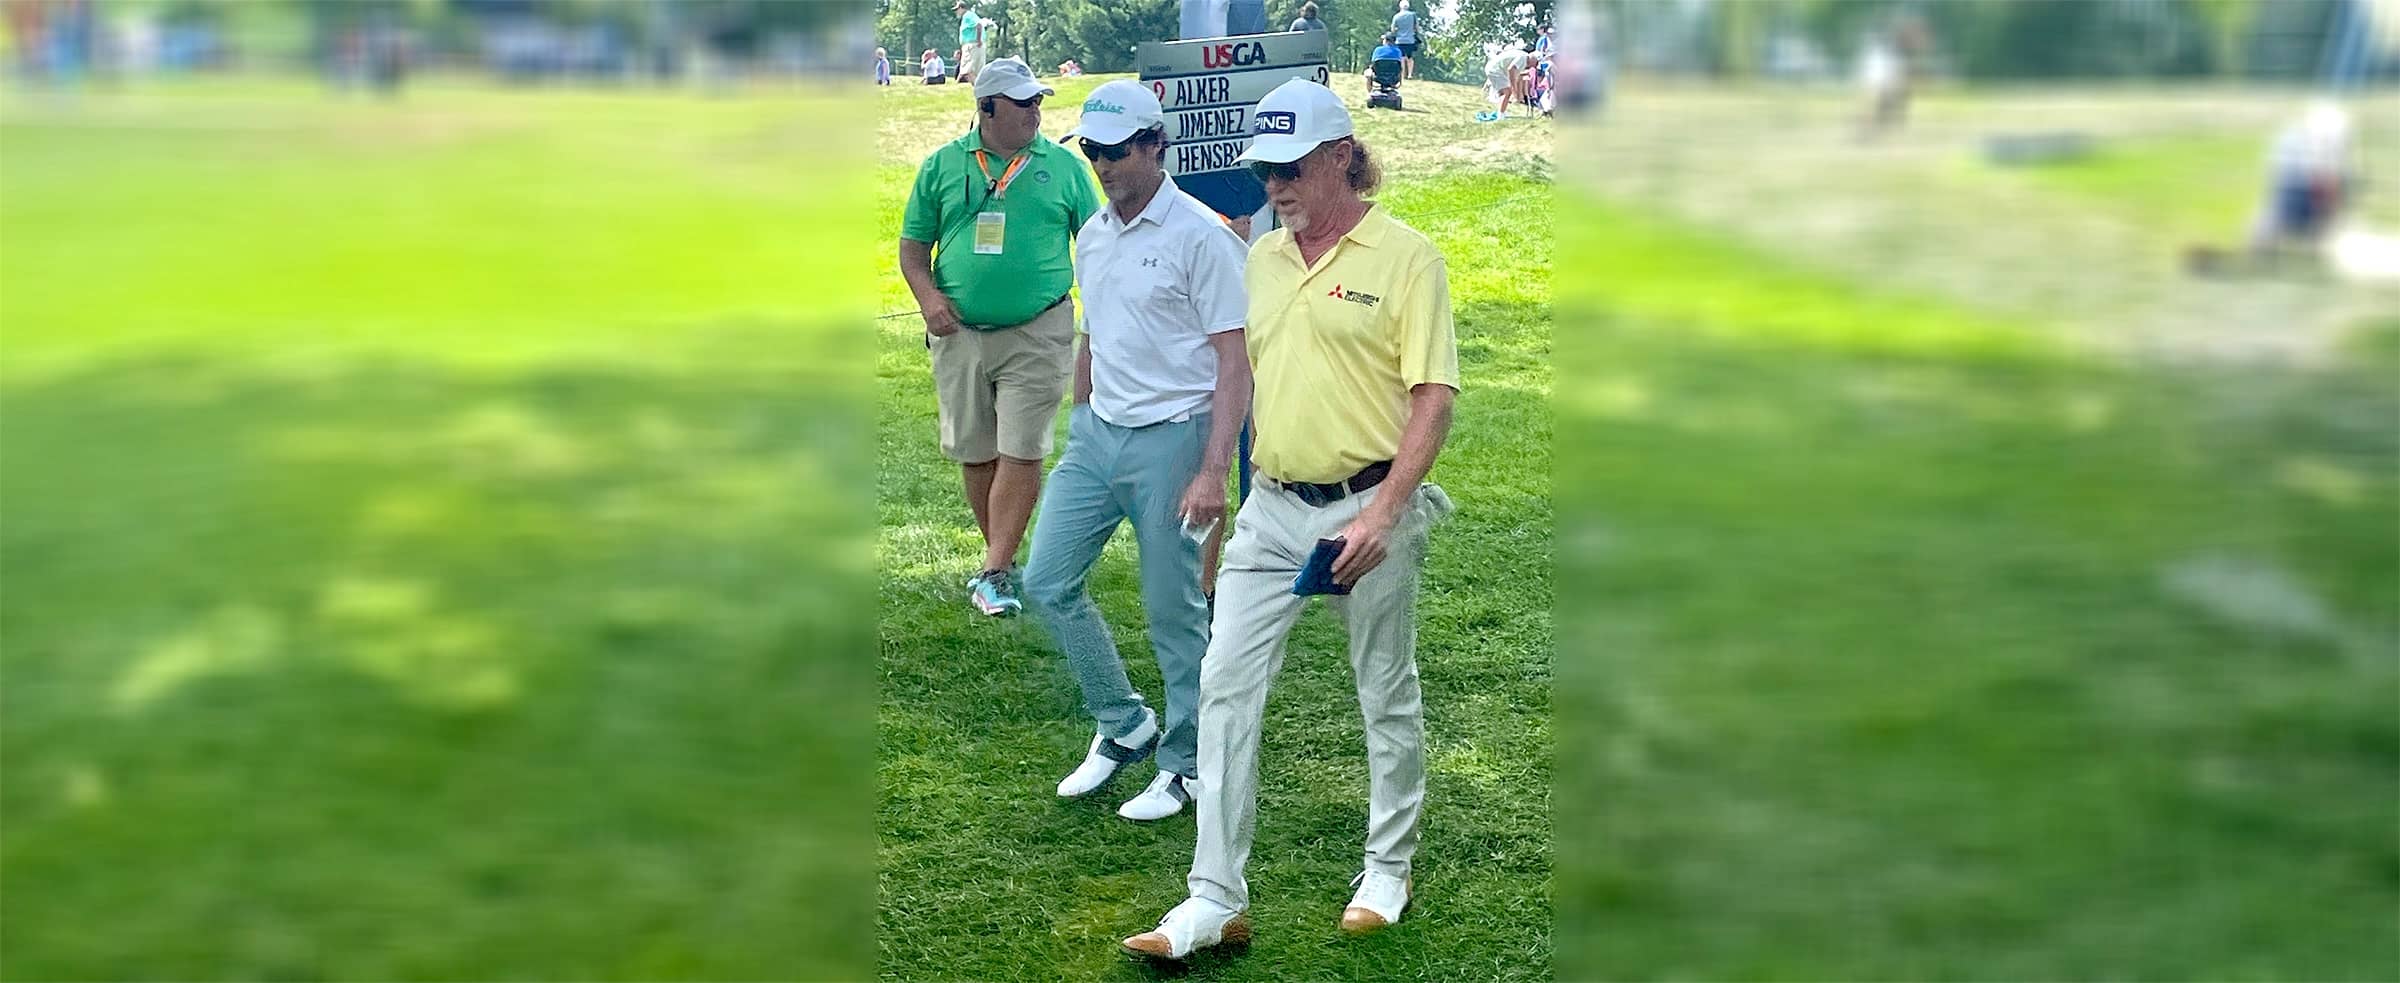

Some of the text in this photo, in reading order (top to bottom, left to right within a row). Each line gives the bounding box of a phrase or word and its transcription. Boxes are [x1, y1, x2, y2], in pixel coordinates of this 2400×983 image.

[1203, 42, 1265, 69] USGA
[1175, 77, 1229, 106] ALKER
[1176, 108, 1245, 139] JIMENEZ
[1177, 141, 1243, 173] HENSBY
